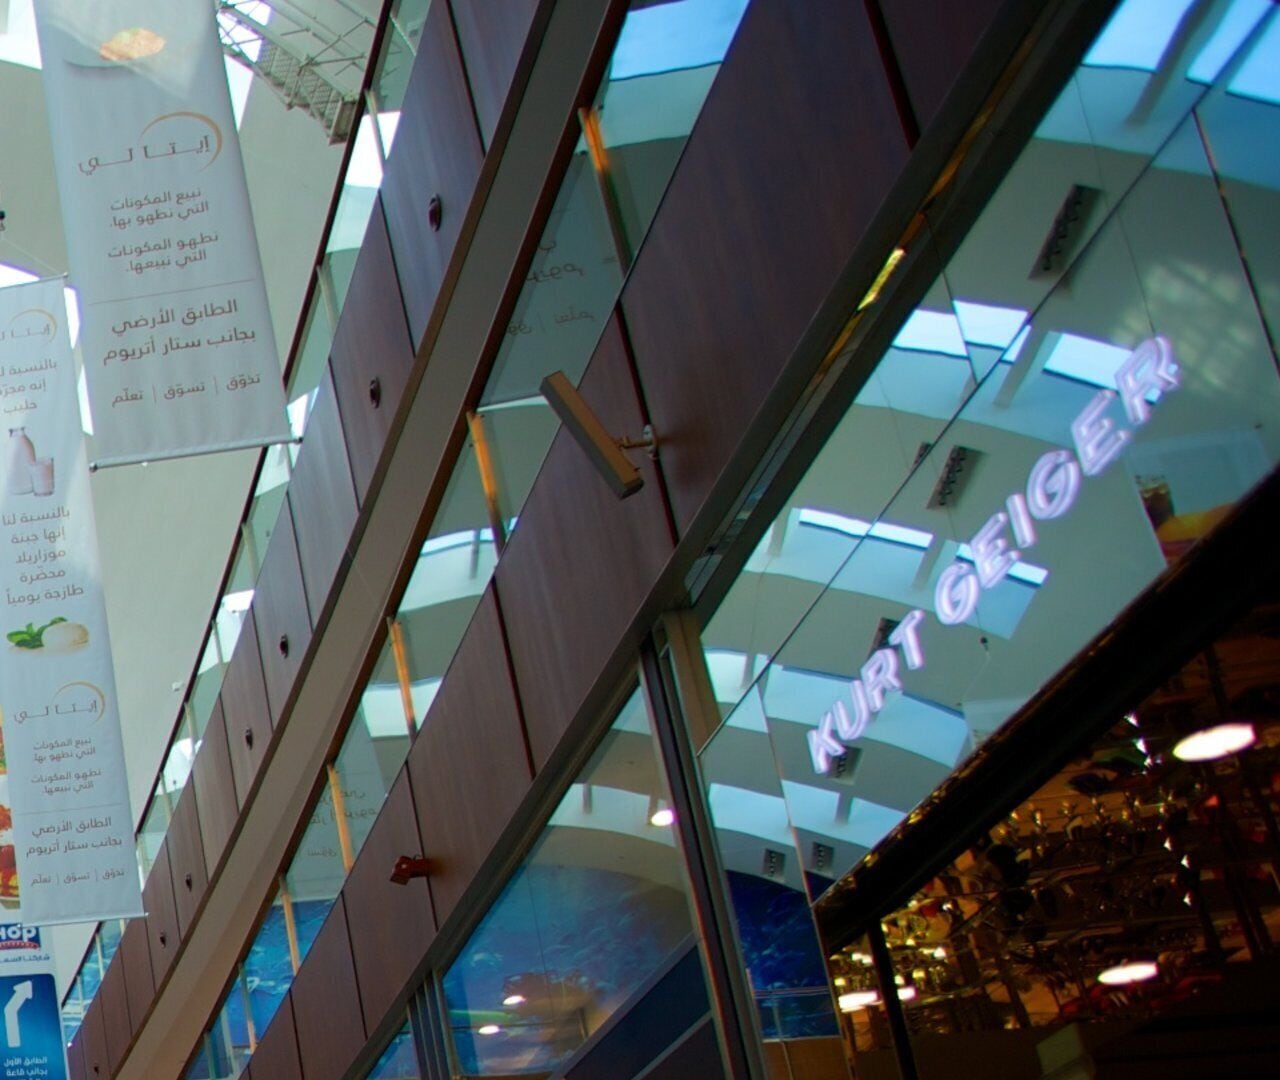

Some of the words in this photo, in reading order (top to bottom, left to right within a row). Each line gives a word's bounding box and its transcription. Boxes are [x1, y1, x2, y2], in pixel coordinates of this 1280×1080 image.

[110, 191, 172, 211] المكونات
[176, 188, 201, 205] نبيع
[178, 201, 209, 221] التي
[108, 239, 172, 258] المكونات
[175, 249, 207, 268] التي
[181, 298, 238, 326] الطابق
[112, 308, 175, 338] الأرضي
[162, 336, 201, 355] ستار
[206, 327, 256, 348] بجانب
[103, 335, 156, 366] أتريوم
[806, 608, 927, 775] KURT
[933, 333, 1183, 626] GEIGER
[76, 816, 112, 833] الطابق
[64, 840, 88, 853] ستار
[91, 836, 122, 849] بجانب
